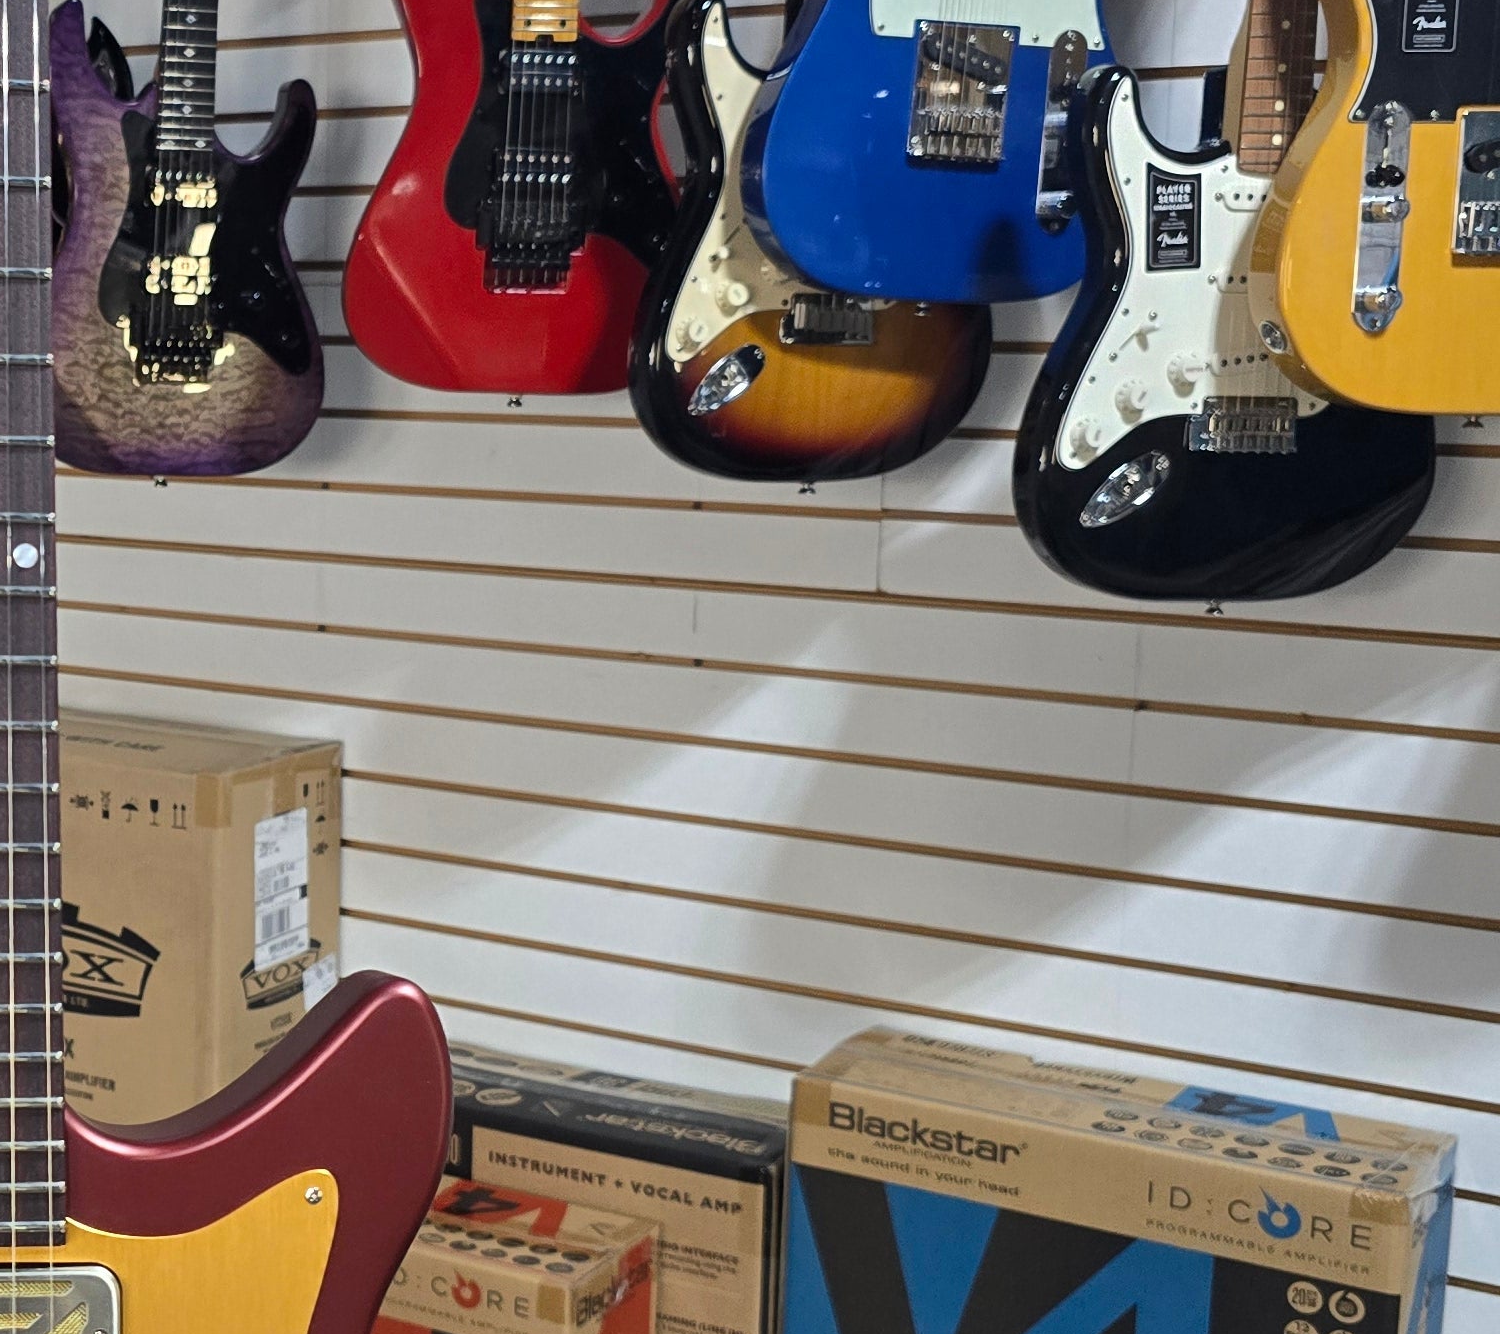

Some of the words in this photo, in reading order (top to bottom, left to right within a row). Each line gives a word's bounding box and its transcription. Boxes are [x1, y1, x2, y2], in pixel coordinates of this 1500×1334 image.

[1156, 183, 1192, 195] PLAYER
[1157, 194, 1190, 204] SERIES
[1156, 231, 1189, 248] Fender
[828, 1100, 1024, 1165] Blackstar
[827, 1147, 856, 1161] the
[860, 1156, 910, 1175] sound
[915, 1164, 930, 1177] in
[935, 1171, 972, 1187] your
[978, 1179, 1022, 1198] head
[872, 1140, 972, 1168] AMPLIFICATION
[488, 1149, 606, 1187] INSTRUMENT
[631, 1180, 693, 1206] VOCAL
[700, 1194, 743, 1215] AMP
[1145, 1218, 1276, 1255] PROGRAMMABLE
[1283, 1248, 1371, 1276] AMPLIFIER
